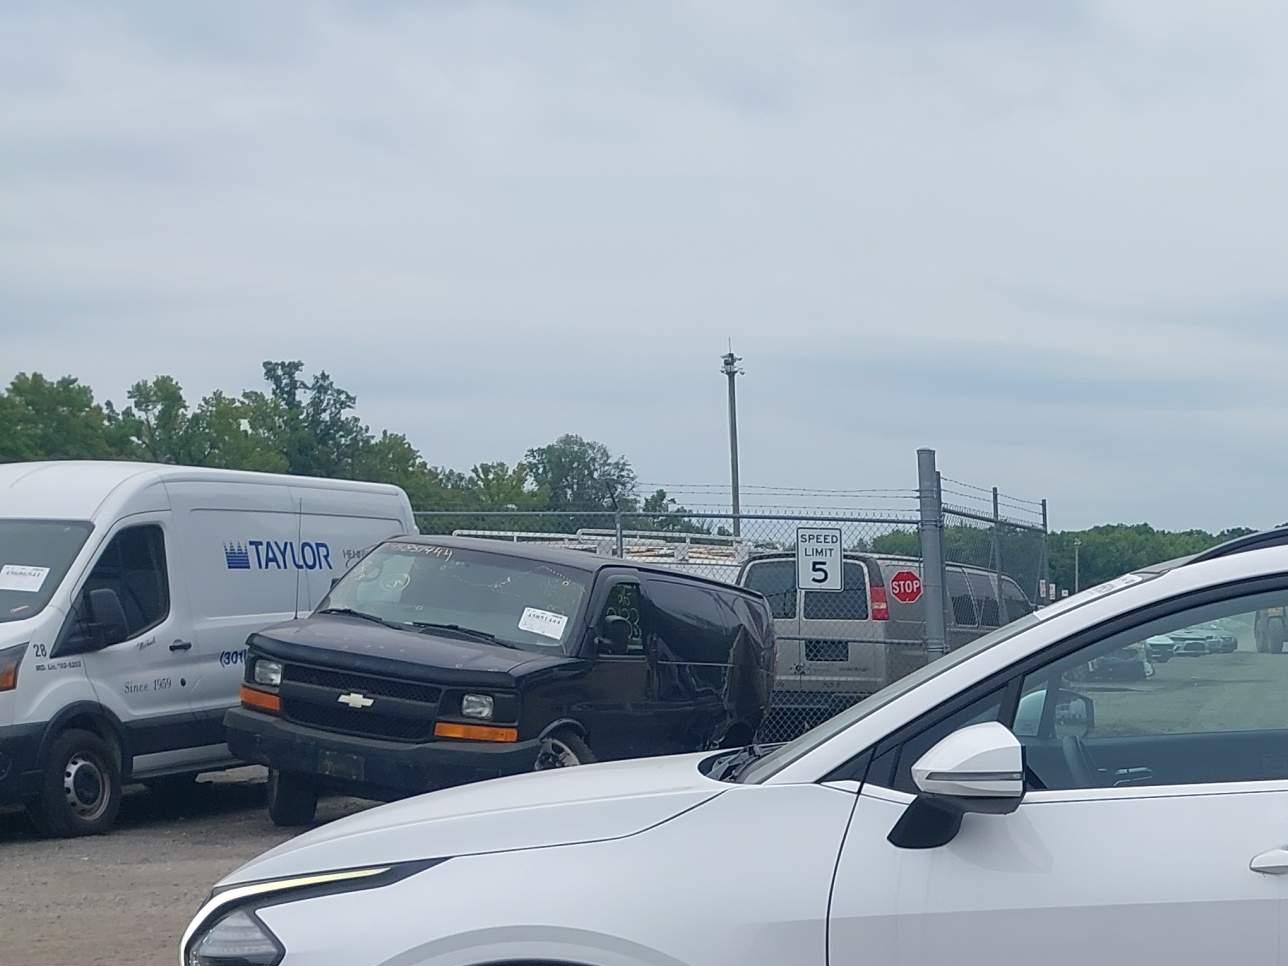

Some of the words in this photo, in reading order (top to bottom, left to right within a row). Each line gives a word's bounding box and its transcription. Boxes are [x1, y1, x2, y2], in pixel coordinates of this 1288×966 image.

[800, 533, 839, 544] SPEED
[249, 540, 333, 570] TAYLOR
[804, 547, 835, 558] LIMIT
[811, 561, 829, 584] 5
[892, 580, 920, 594] STOP
[33, 643, 47, 657] 28
[124, 680, 148, 694] Since
